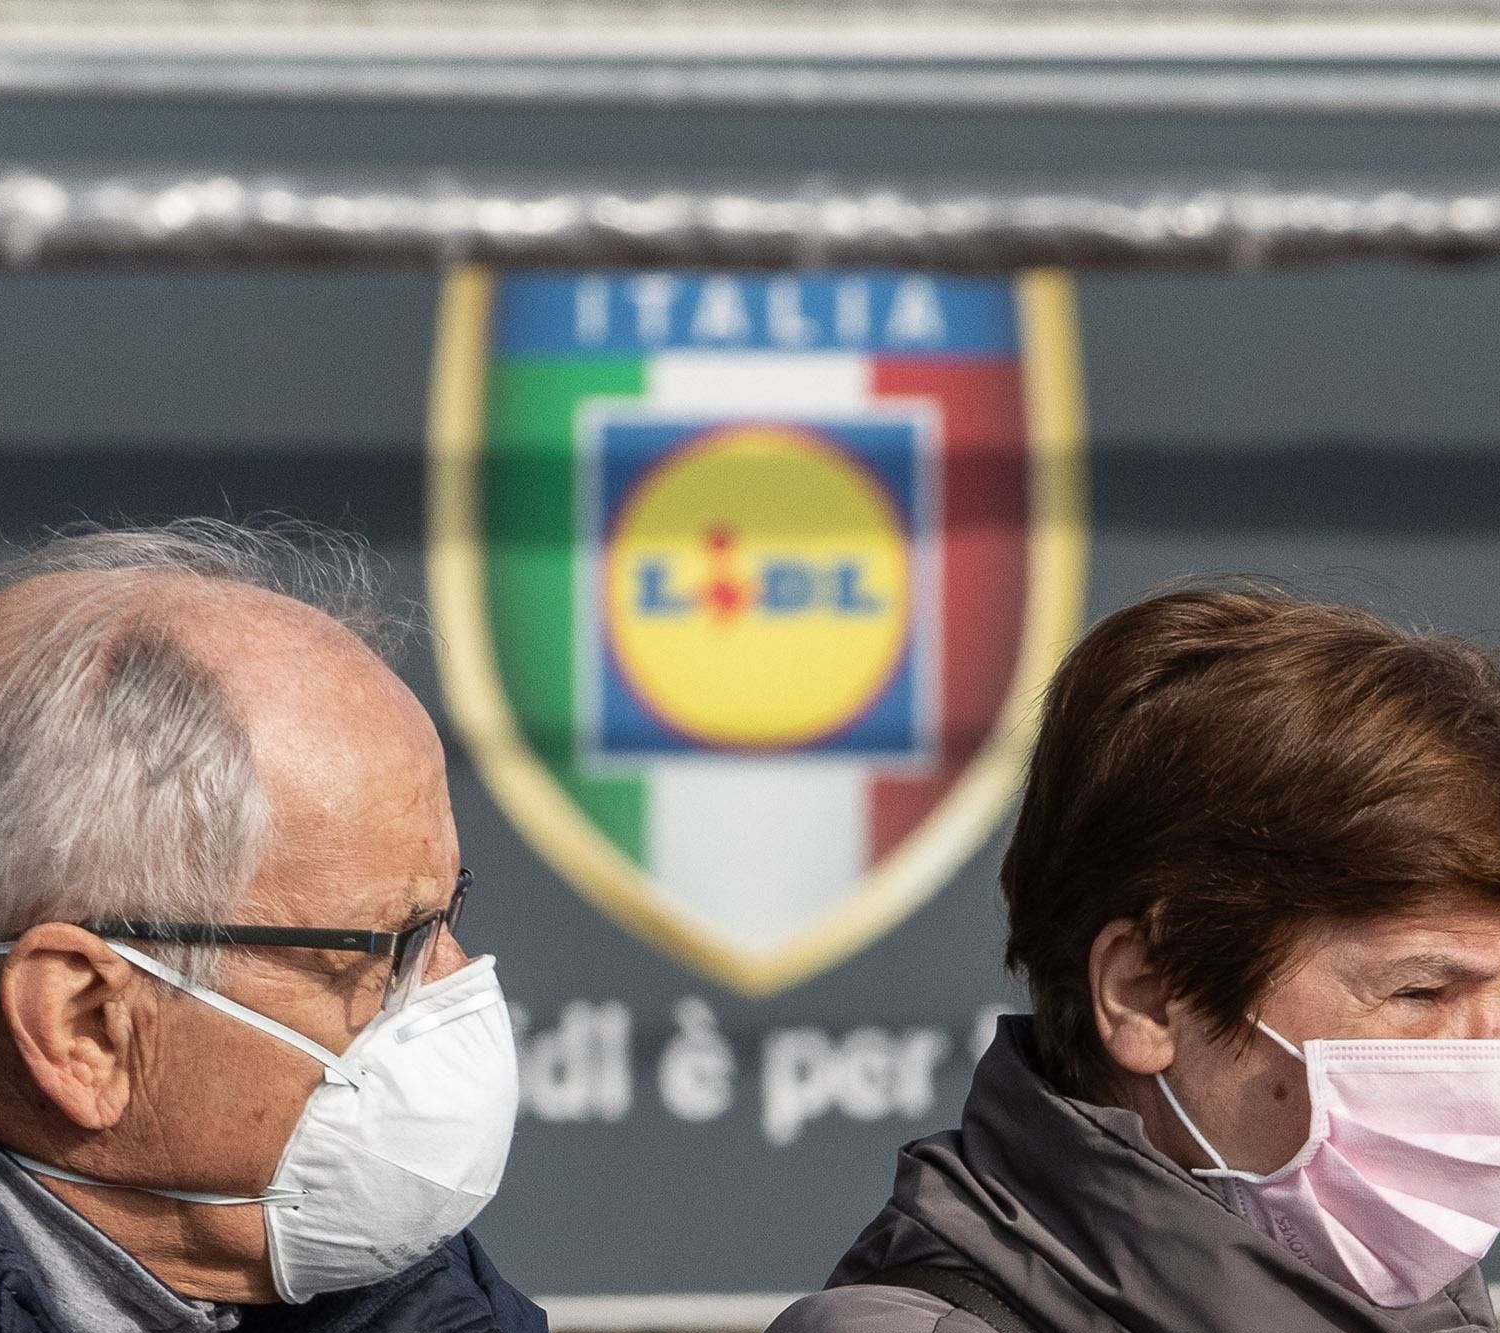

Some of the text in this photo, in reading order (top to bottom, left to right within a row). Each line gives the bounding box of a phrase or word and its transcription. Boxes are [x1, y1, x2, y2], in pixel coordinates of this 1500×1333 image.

[574, 276, 947, 345] ITALIA
[658, 998, 735, 1120] è
[763, 1020, 948, 1146] per
